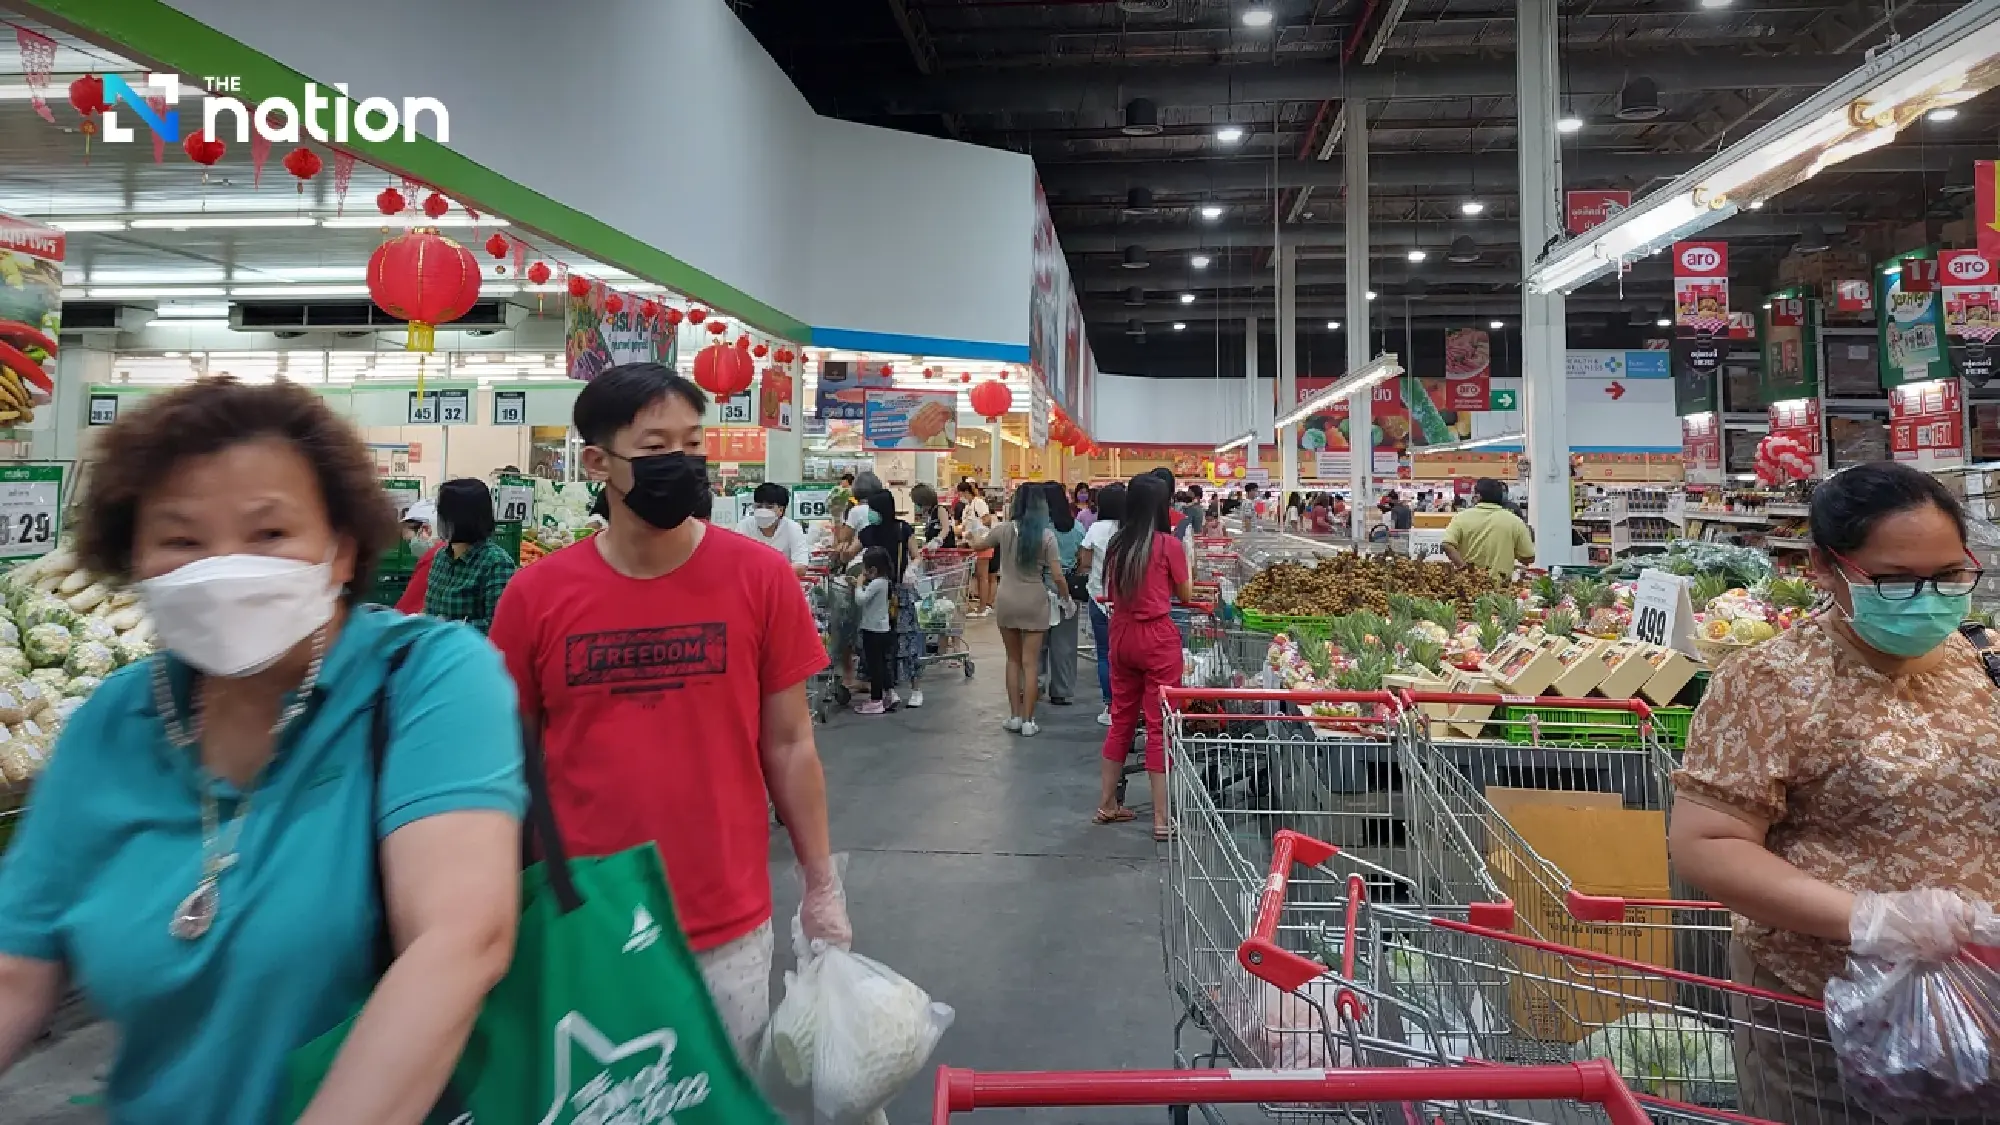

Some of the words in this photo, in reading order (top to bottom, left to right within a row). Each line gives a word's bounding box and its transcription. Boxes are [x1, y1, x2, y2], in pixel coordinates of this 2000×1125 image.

[1687, 253, 1716, 266] aro
[1953, 261, 1986, 273] aro
[1907, 259, 1938, 281] 17
[1838, 281, 1870, 300] 18
[1775, 299, 1802, 316] 19
[1729, 312, 1755, 329] 20
[1646, 338, 1670, 351] 22
[414, 407, 432, 420] 45
[444, 407, 461, 420] 32
[501, 408, 518, 420] 19
[725, 405, 743, 418] 35
[504, 502, 527, 521] 49
[799, 501, 827, 517] 69
[19, 511, 50, 543] 29
[1636, 605, 1667, 646] 499
[589, 640, 701, 670] FREEDOM
